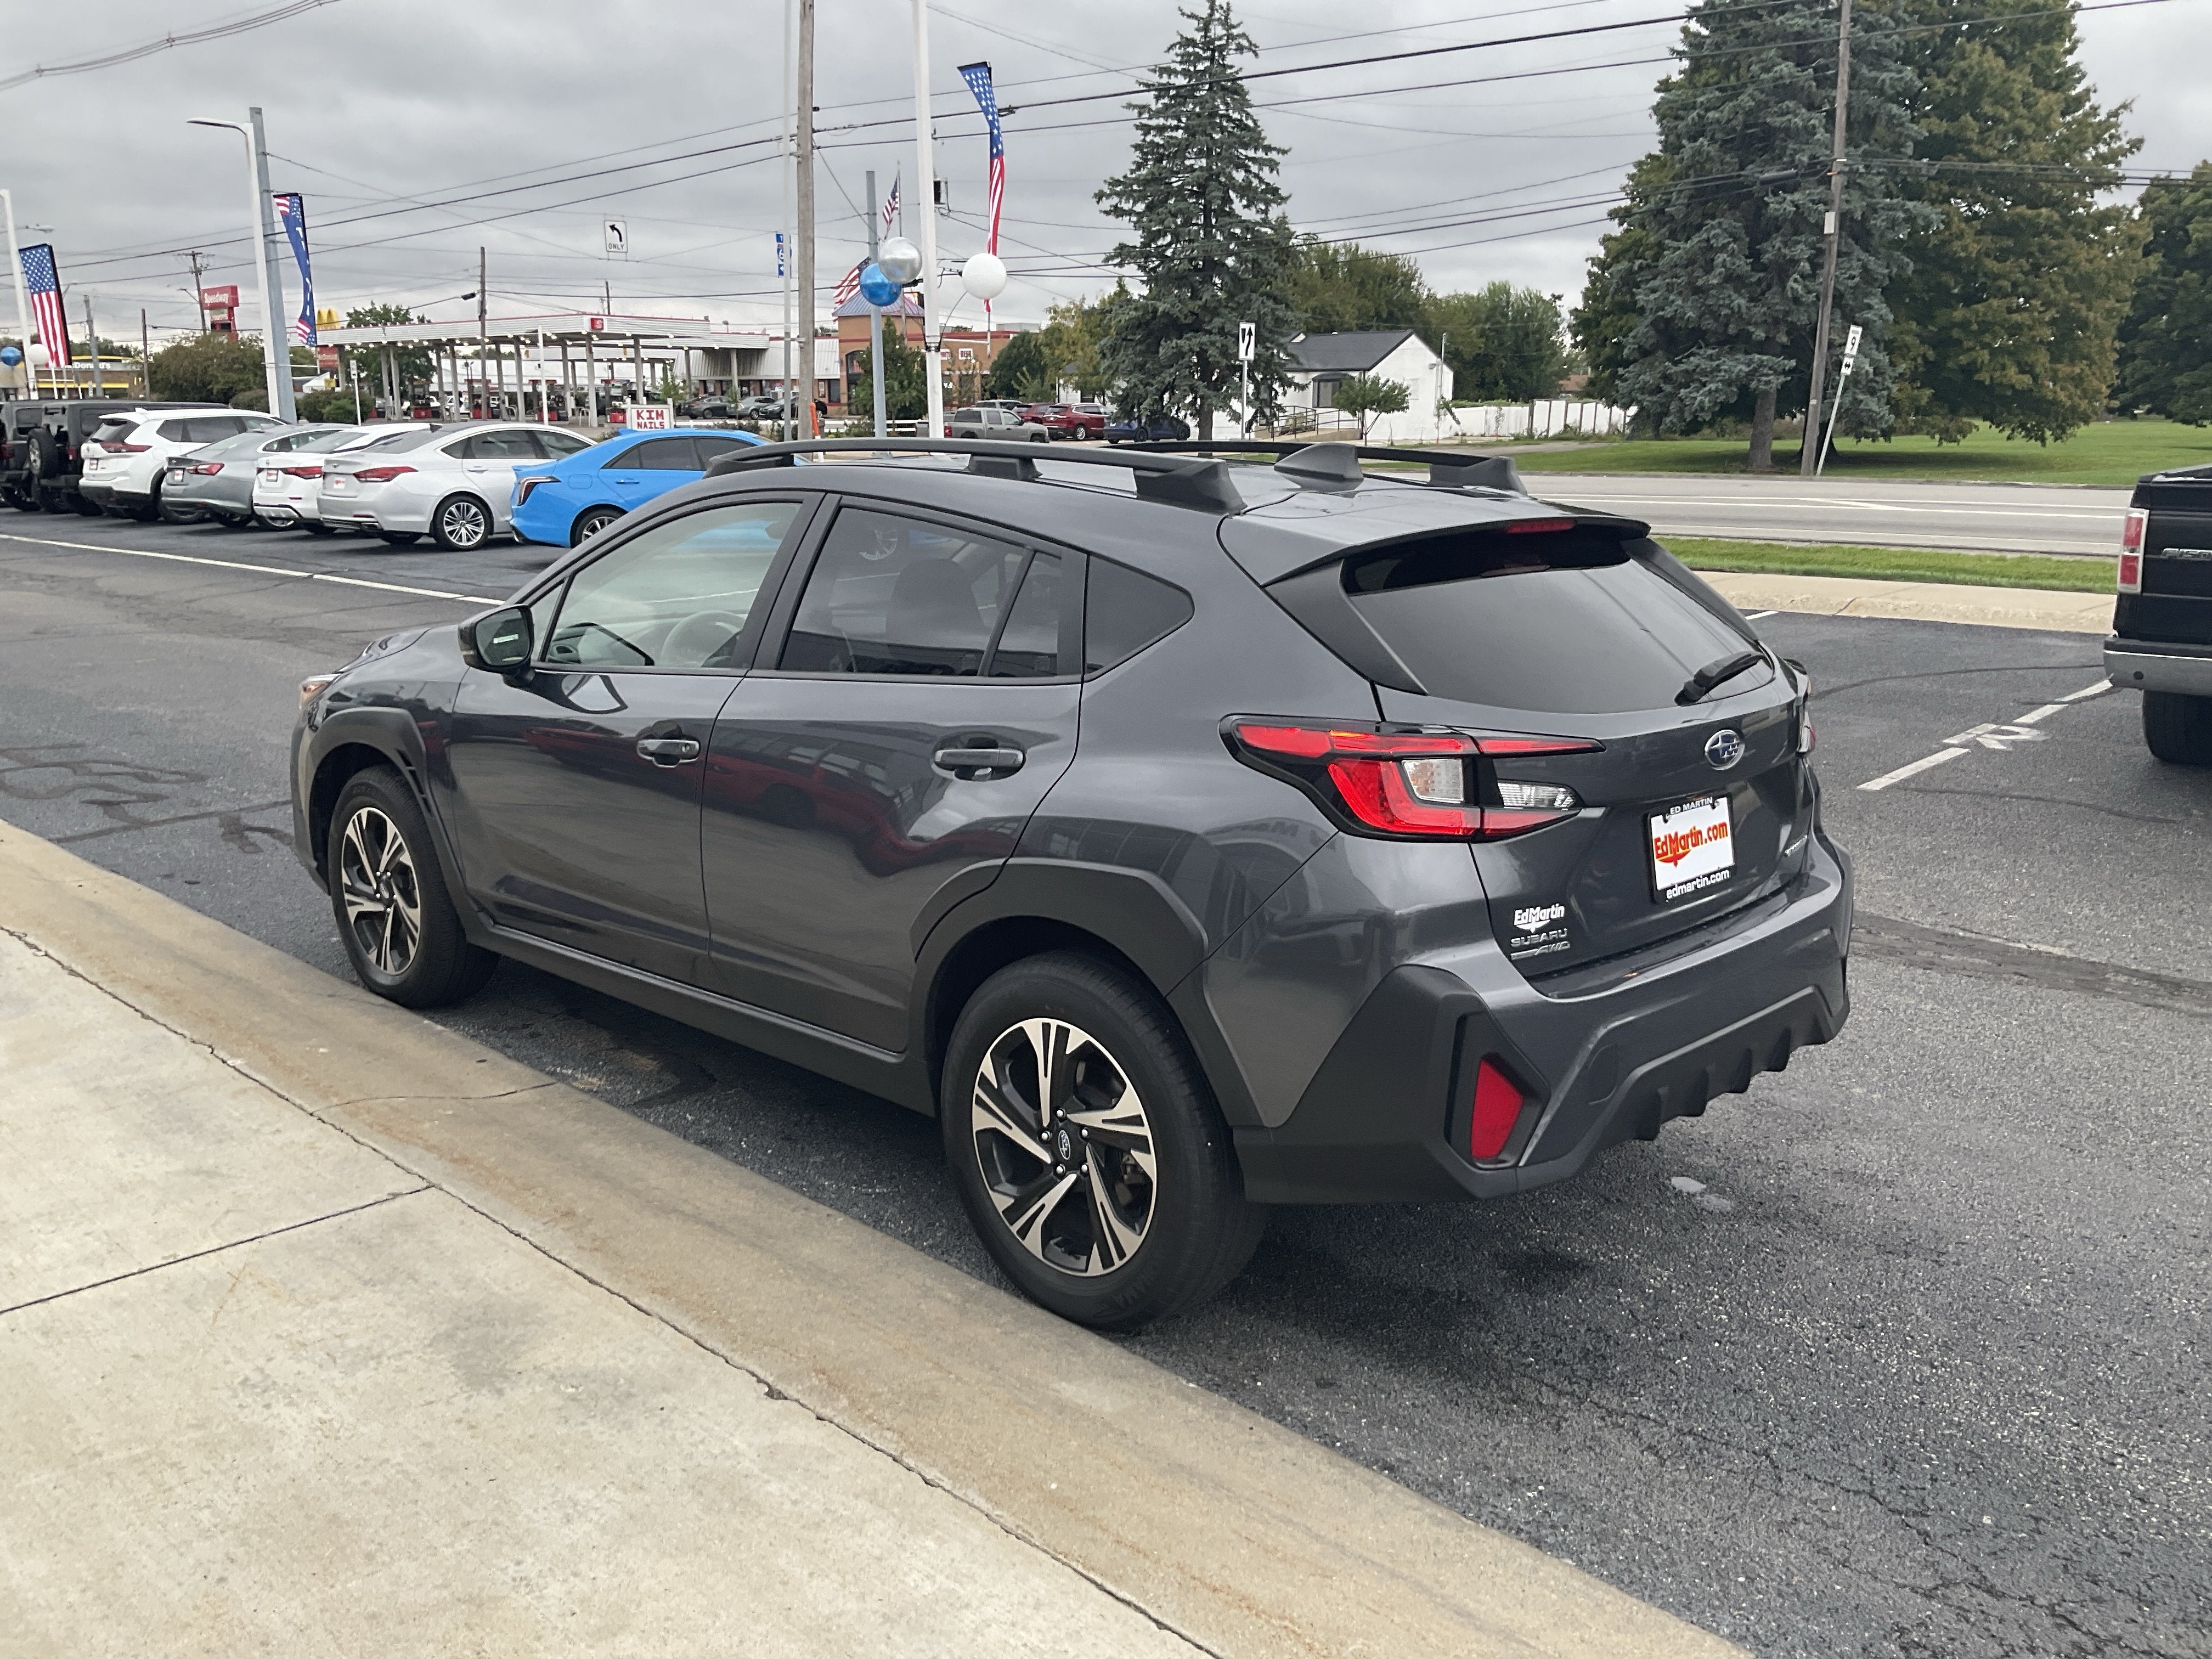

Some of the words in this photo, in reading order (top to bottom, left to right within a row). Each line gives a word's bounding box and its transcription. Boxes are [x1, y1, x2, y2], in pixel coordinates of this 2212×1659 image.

[204, 292, 229, 306] Speedway
[1850, 336, 1856, 351] 9
[636, 410, 664, 420] KIM
[1670, 805, 1681, 815] ED
[1683, 797, 1713, 812] MARTIN
[1654, 822, 1728, 860] EdMartin.com
[1666, 869, 1730, 899] edmartin.com
[1514, 903, 1565, 927] EdMartin
[1510, 928, 1567, 947] SUBARU
